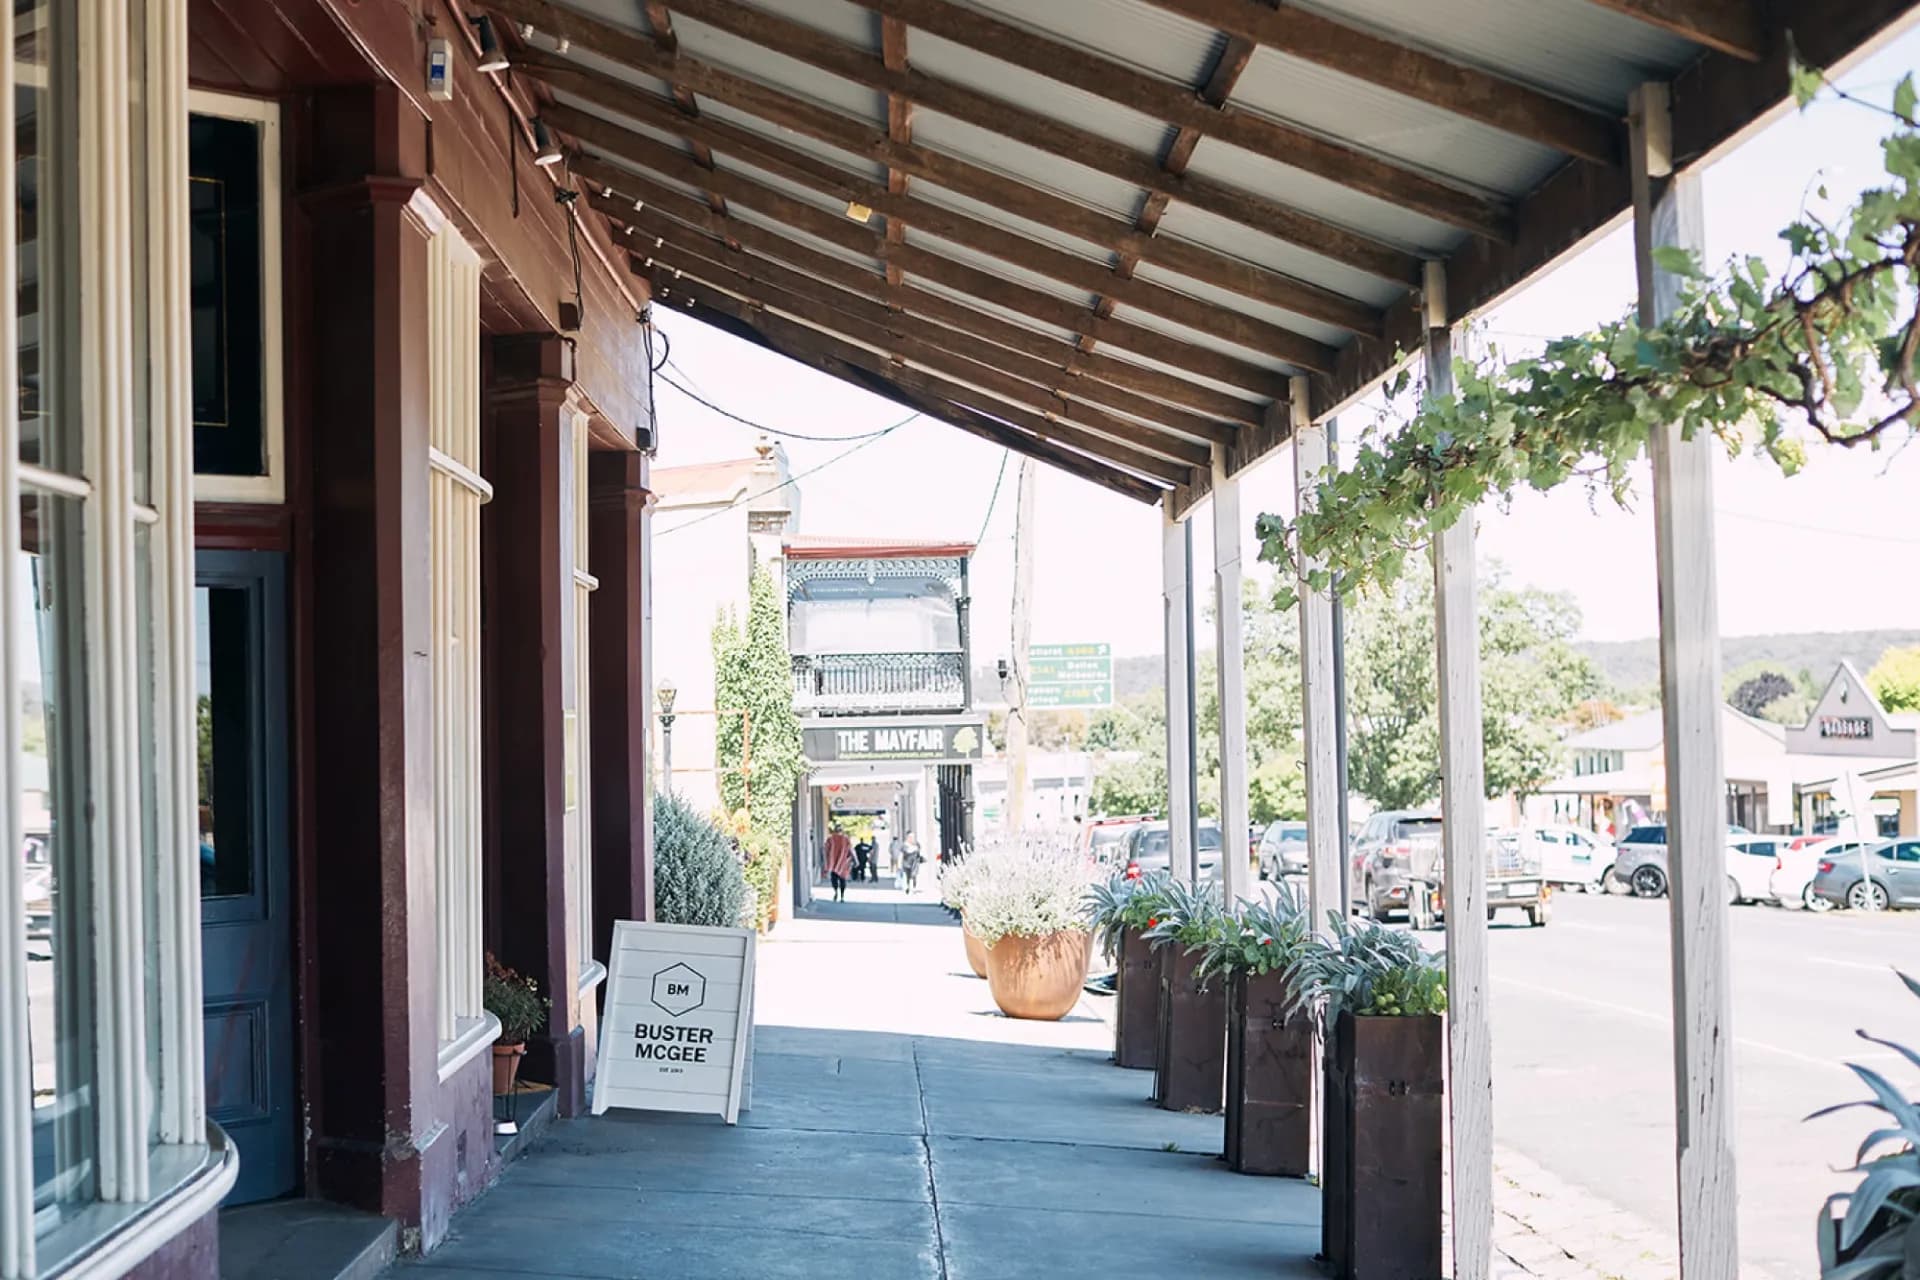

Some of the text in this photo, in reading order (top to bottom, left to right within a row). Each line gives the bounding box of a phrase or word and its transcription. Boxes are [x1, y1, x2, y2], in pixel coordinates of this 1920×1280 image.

[1029, 648, 1063, 657] allarat
[837, 728, 944, 752] THE MAYFAIR
[667, 983, 690, 996] BM
[634, 1023, 714, 1044] BUSTER
[634, 1043, 707, 1063] MCGEE
